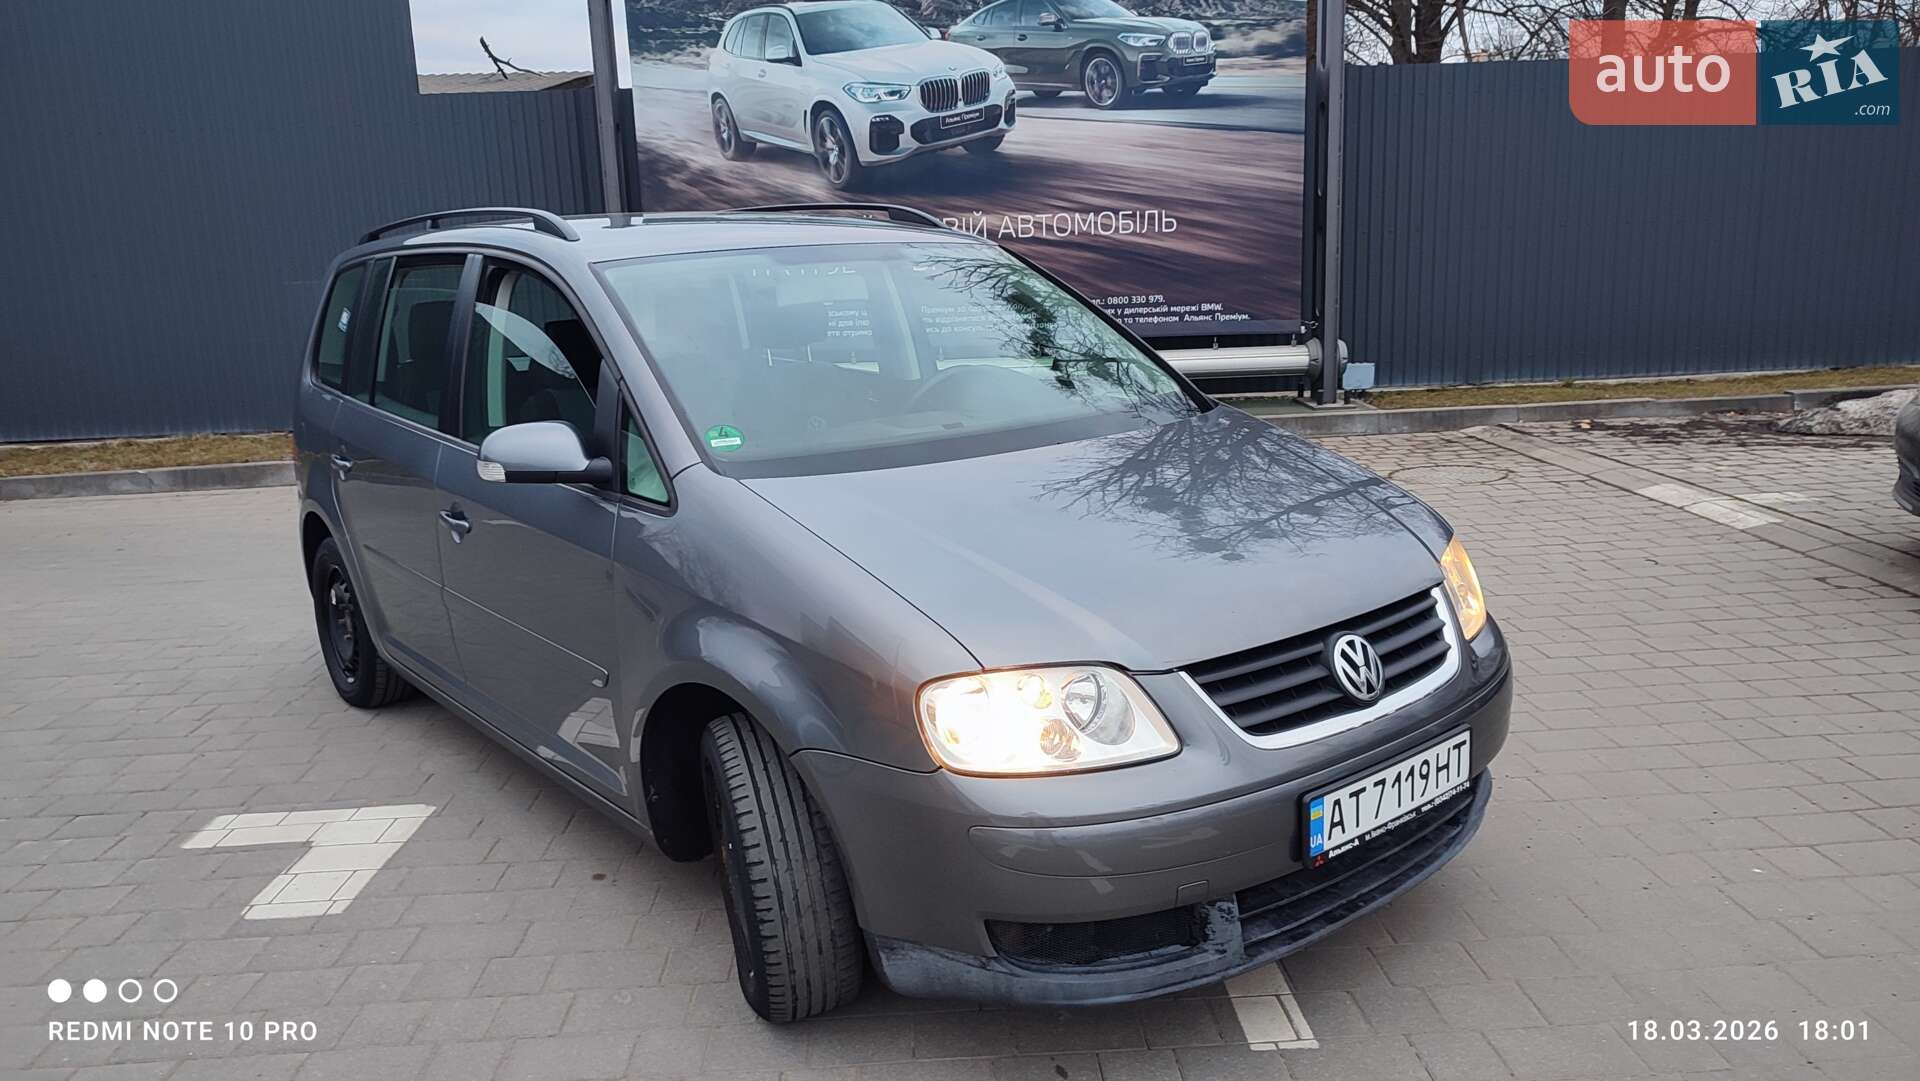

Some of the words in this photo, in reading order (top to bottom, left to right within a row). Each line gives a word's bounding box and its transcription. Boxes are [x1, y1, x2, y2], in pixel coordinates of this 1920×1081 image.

[943, 210, 987, 241] ВІЙ
[998, 210, 1178, 239] АВТОМОБІЛЬ
[1107, 296, 1129, 305] 0800
[1131, 295, 1147, 304] 330
[1124, 304, 1168, 315] дилерській
[1170, 303, 1199, 313] мережі
[1201, 302, 1223, 311] BMW.
[1135, 315, 1180, 324] телефоном
[1183, 313, 1213, 322] Альянс
[1310, 833, 1323, 848] UA
